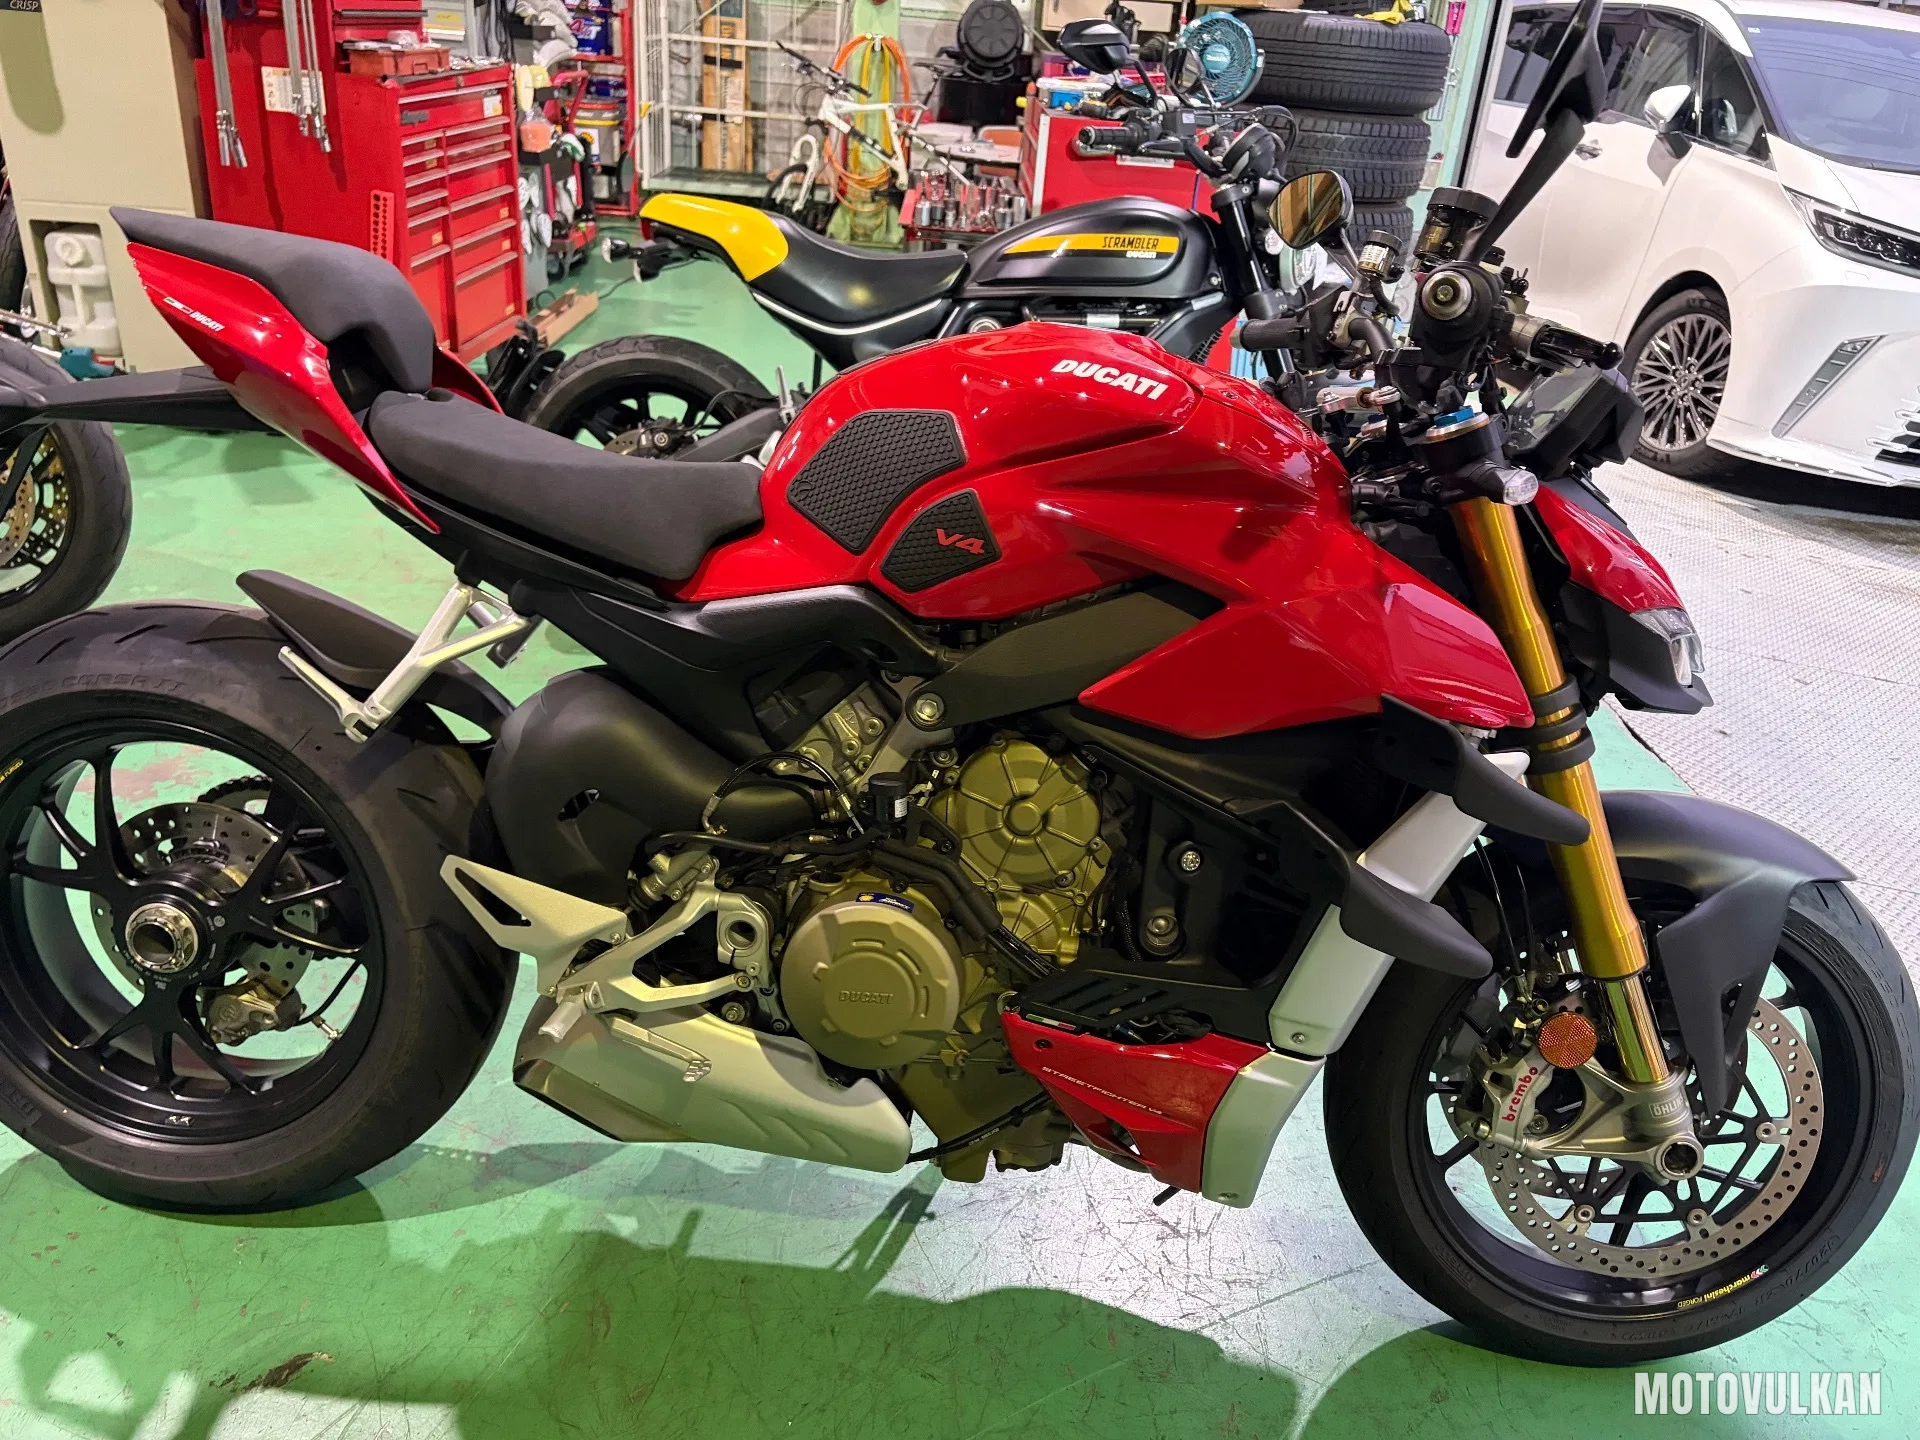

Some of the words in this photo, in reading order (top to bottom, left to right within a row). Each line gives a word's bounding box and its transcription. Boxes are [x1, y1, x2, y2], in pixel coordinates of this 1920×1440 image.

[1102, 236, 1160, 250] SCRAMBLER
[1126, 250, 1157, 259] DUCATI
[189, 311, 225, 332] DUCATI
[1050, 359, 1169, 400] DUCATI
[936, 528, 985, 554] V4
[838, 989, 893, 1004] DUCATI
[1042, 1065, 1147, 1109] STREETFIGHTER
[1502, 1066, 1538, 1122] brembo
[1703, 1274, 1751, 1303] marchesini
[1677, 1297, 1706, 1308] FORGED
